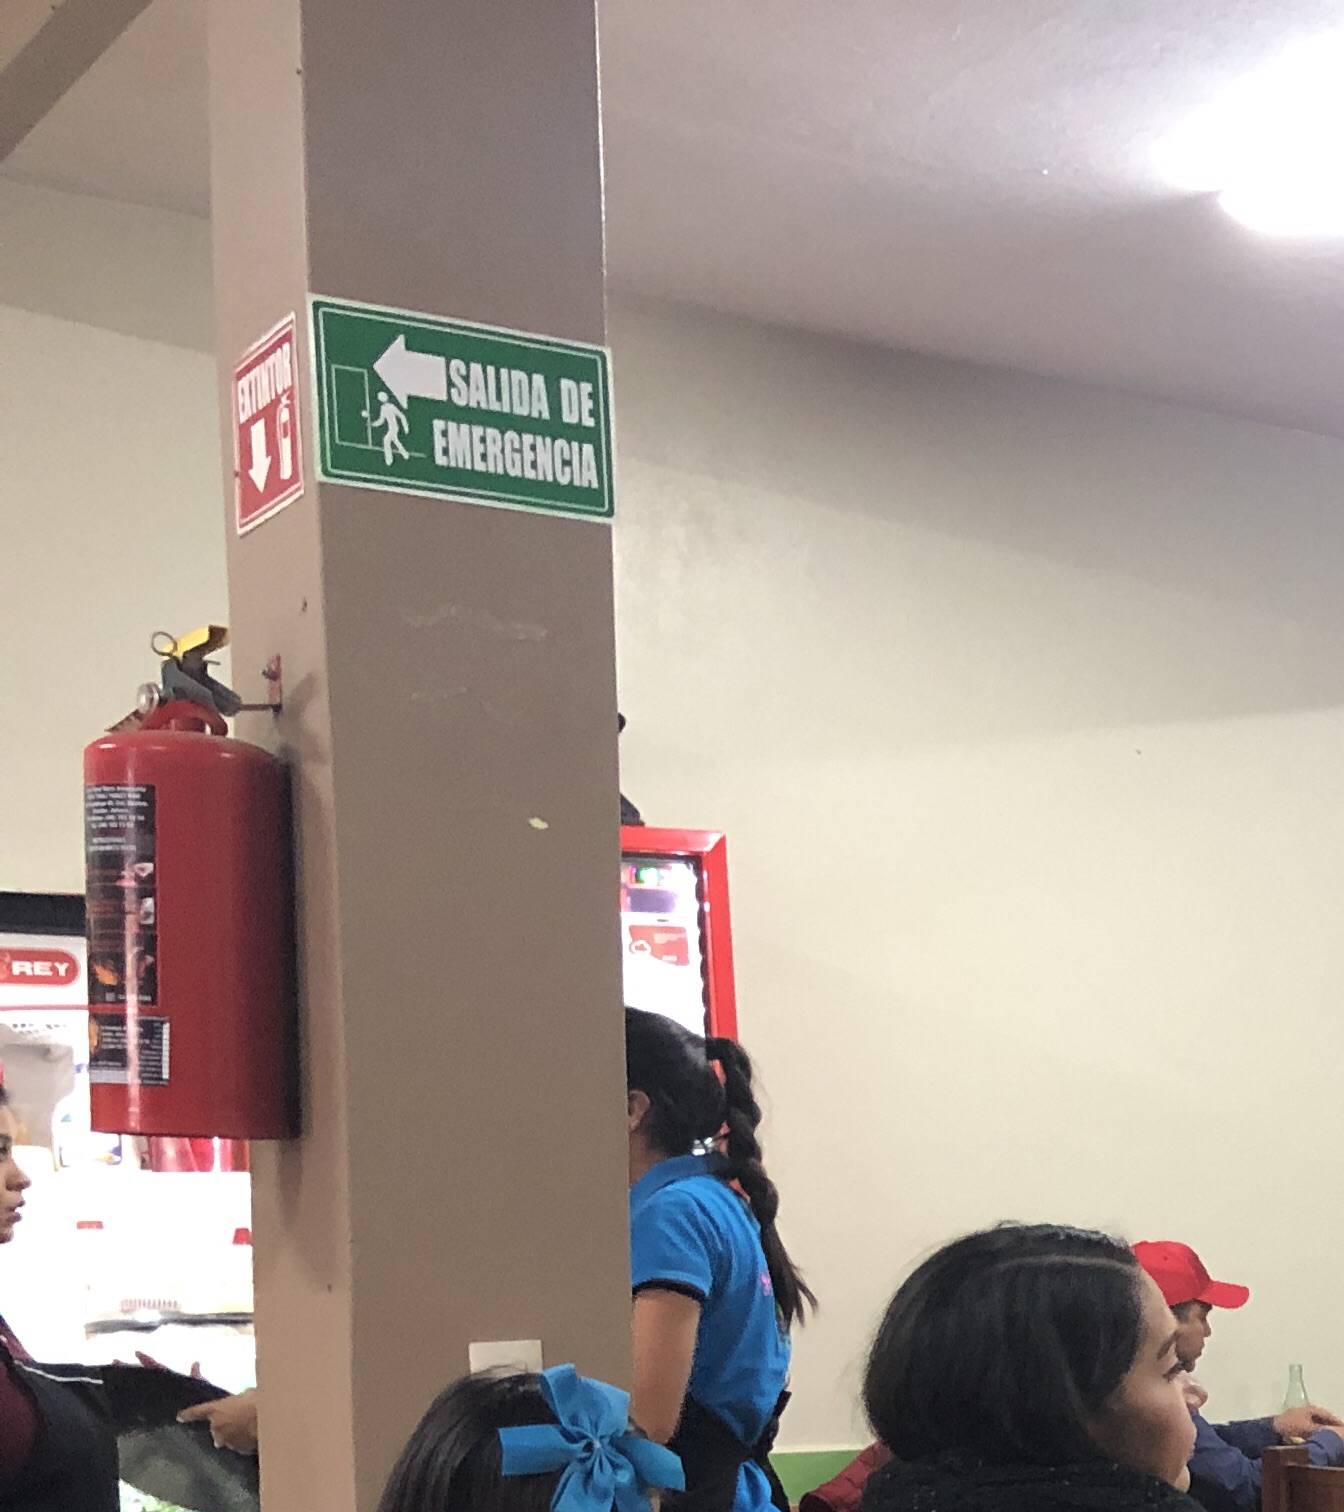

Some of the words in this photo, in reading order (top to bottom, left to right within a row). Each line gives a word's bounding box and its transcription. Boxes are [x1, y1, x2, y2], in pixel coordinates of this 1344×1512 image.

[238, 342, 293, 424] EXTINTOR
[450, 358, 551, 421] SALIDA
[560, 377, 596, 428] DE
[432, 418, 599, 490] EMERGENCIA
[11, 960, 70, 977] REY
